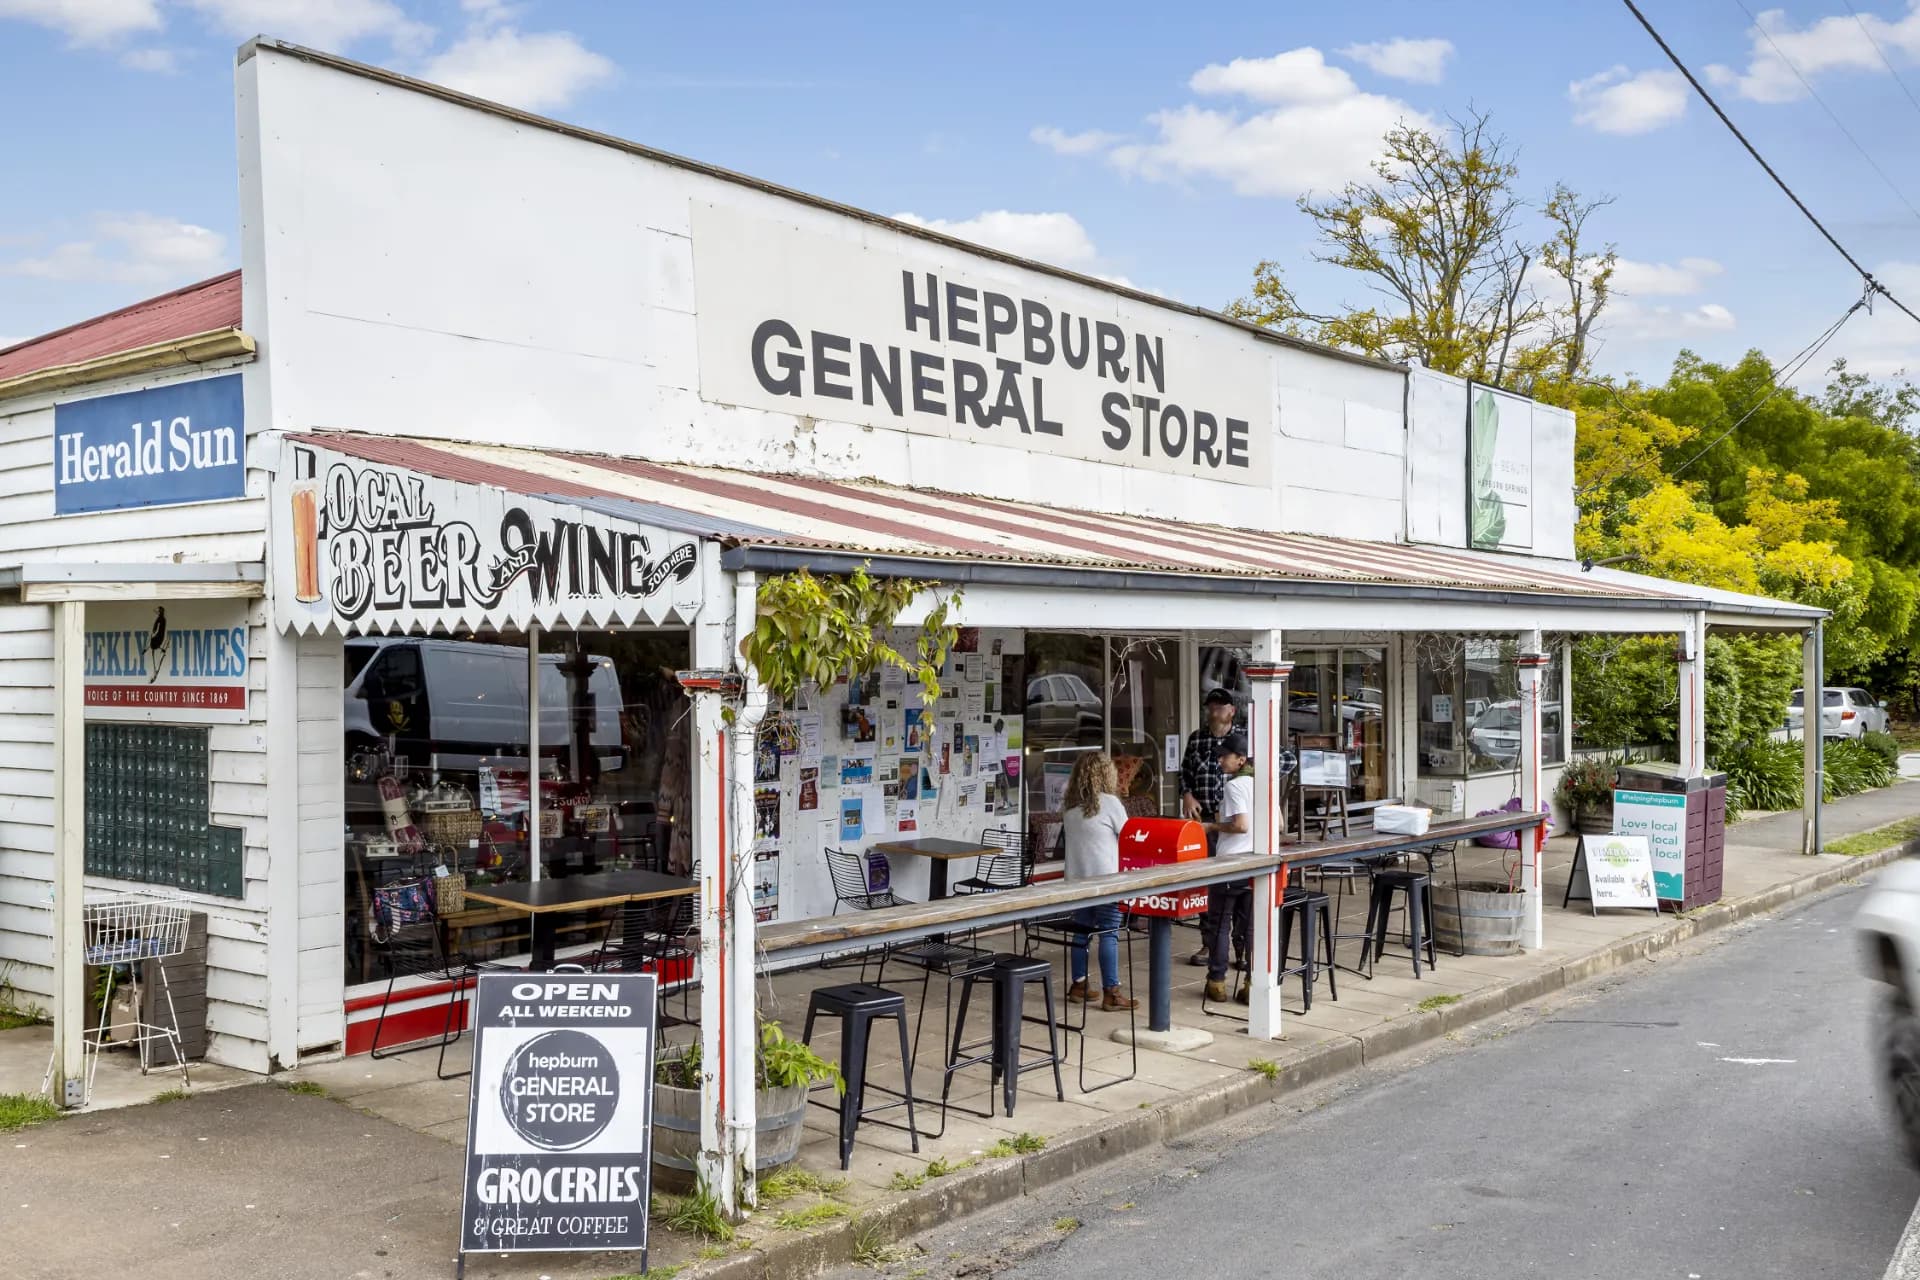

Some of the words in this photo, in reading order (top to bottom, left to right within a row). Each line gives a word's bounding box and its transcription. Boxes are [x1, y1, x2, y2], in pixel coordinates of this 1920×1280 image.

[902, 270, 1165, 393] HEPBURN
[751, 318, 1063, 436] GENERAL
[1101, 392, 1250, 468] STORE
[59, 420, 164, 485] Herald
[169, 416, 237, 472] Sun
[500, 507, 651, 607] WINE
[500, 551, 530, 584] AND
[330, 520, 503, 621] BEER
[649, 562, 671, 592] SOLD
[669, 546, 694, 567] HERE
[84, 632, 149, 677] EEKLY
[167, 627, 245, 677] TIMES
[87, 690, 109, 701] VOICE
[112, 691, 122, 701] OF
[126, 691, 140, 702] THE
[144, 691, 178, 702] COUNTRY
[182, 692, 205, 703] SINCE
[210, 692, 228, 704] 1869
[1621, 817, 1648, 829] Love
[1651, 819, 1677, 832] local
[1652, 834, 1678, 845] local
[1656, 848, 1682, 860] local
[1139, 896, 1178, 911] POST
[1190, 896, 1208, 909] POST
[511, 983, 620, 1001] OPEN
[498, 1005, 534, 1018] ALL
[539, 1005, 632, 1018] WEEKEND
[529, 1052, 598, 1070] hepburn
[510, 1076, 614, 1097] GENERAL
[526, 1102, 596, 1123] STORE
[476, 1166, 640, 1204] GROCERIES
[473, 1219, 486, 1236] &
[491, 1217, 552, 1236] GREAT
[557, 1215, 628, 1235] COFFEE
